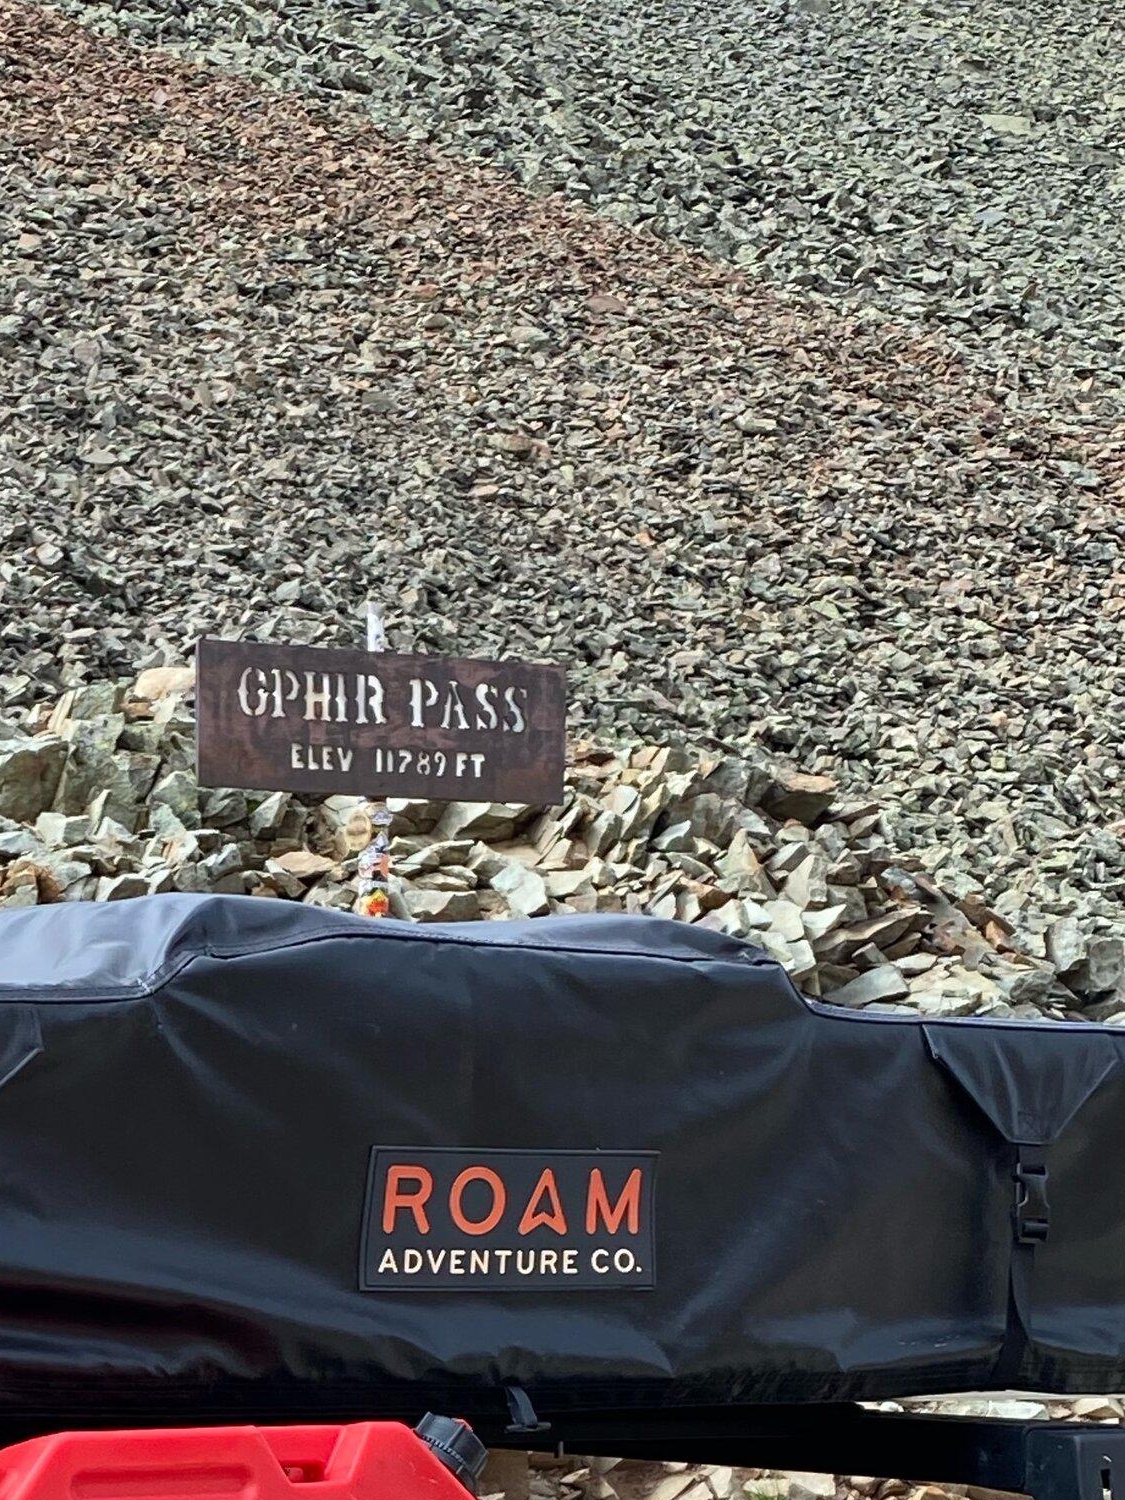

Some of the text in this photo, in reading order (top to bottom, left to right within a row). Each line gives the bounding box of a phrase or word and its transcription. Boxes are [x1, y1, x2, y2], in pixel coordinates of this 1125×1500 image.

[237, 666, 528, 733] OPHIR PASS
[290, 742, 486, 778] ELEV 11789 FT
[382, 1164, 642, 1236] ROAM
[378, 1247, 643, 1275] ADVENTURE CO.
